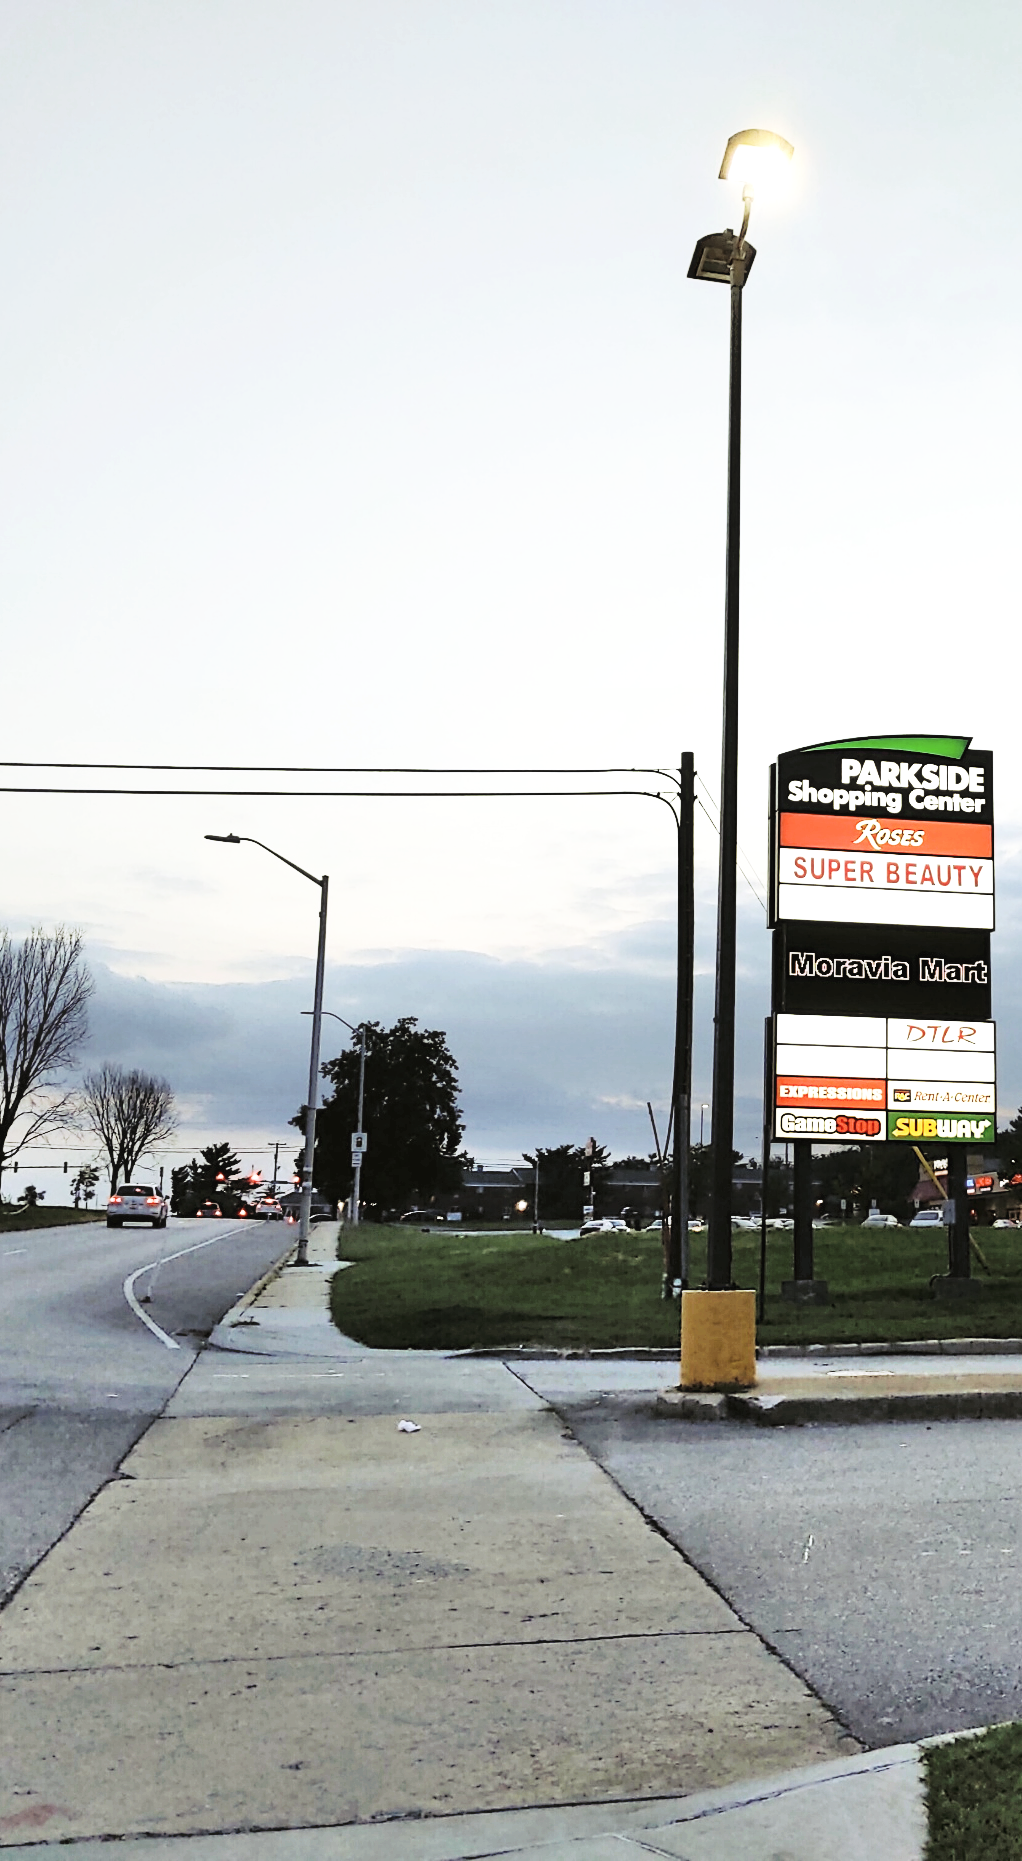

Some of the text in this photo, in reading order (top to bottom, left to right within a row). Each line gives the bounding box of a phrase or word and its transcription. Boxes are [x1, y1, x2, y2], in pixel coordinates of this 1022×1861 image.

[841, 758, 985, 793] PARKSIDE
[788, 779, 986, 813] Shopping Center
[793, 856, 983, 887] SUPER BEAUTY
[789, 951, 988, 984] Moravia Mart
[906, 1024, 977, 1045] DTLR
[779, 1085, 883, 1101] EXPRESSIONS
[781, 1113, 881, 1137] GameStop
[892, 1117, 992, 1139] SUBWAY
